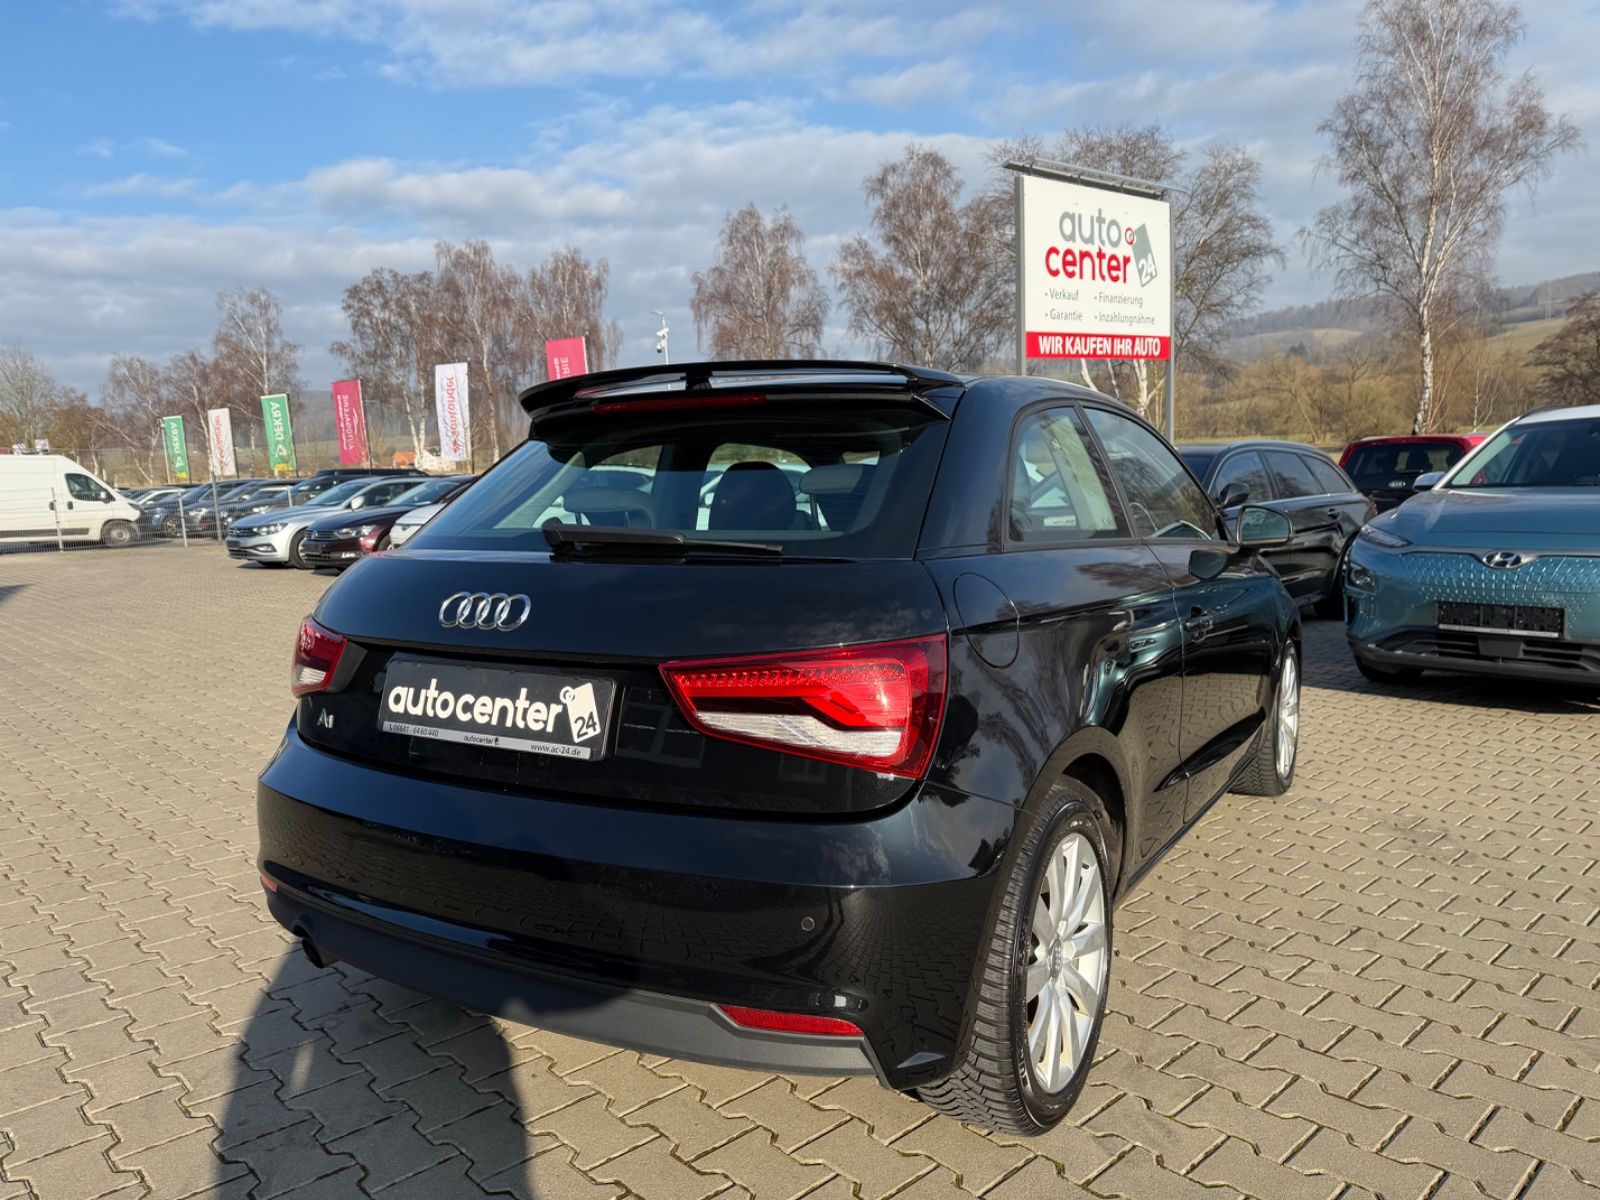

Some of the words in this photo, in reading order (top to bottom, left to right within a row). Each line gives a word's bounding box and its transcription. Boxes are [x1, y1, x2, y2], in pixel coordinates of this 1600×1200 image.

[1059, 208, 1122, 248] auto
[1045, 246, 1131, 284] center
[1139, 252, 1156, 284] 24
[1049, 288, 1079, 301] Verkauf
[1098, 291, 1143, 308] Finanzierung
[1050, 308, 1083, 321] Garantie
[1098, 312, 1155, 326] Inzahlungnahme
[1038, 335, 1063, 354] WIR
[1065, 336, 1112, 355] KAUFEN
[1113, 337, 1133, 356] IHR
[1134, 338, 1161, 356] AUTO
[388, 679, 562, 733] autocenter
[574, 712, 597, 739] 24
[530, 743, 581, 756] www.ac-24.de
